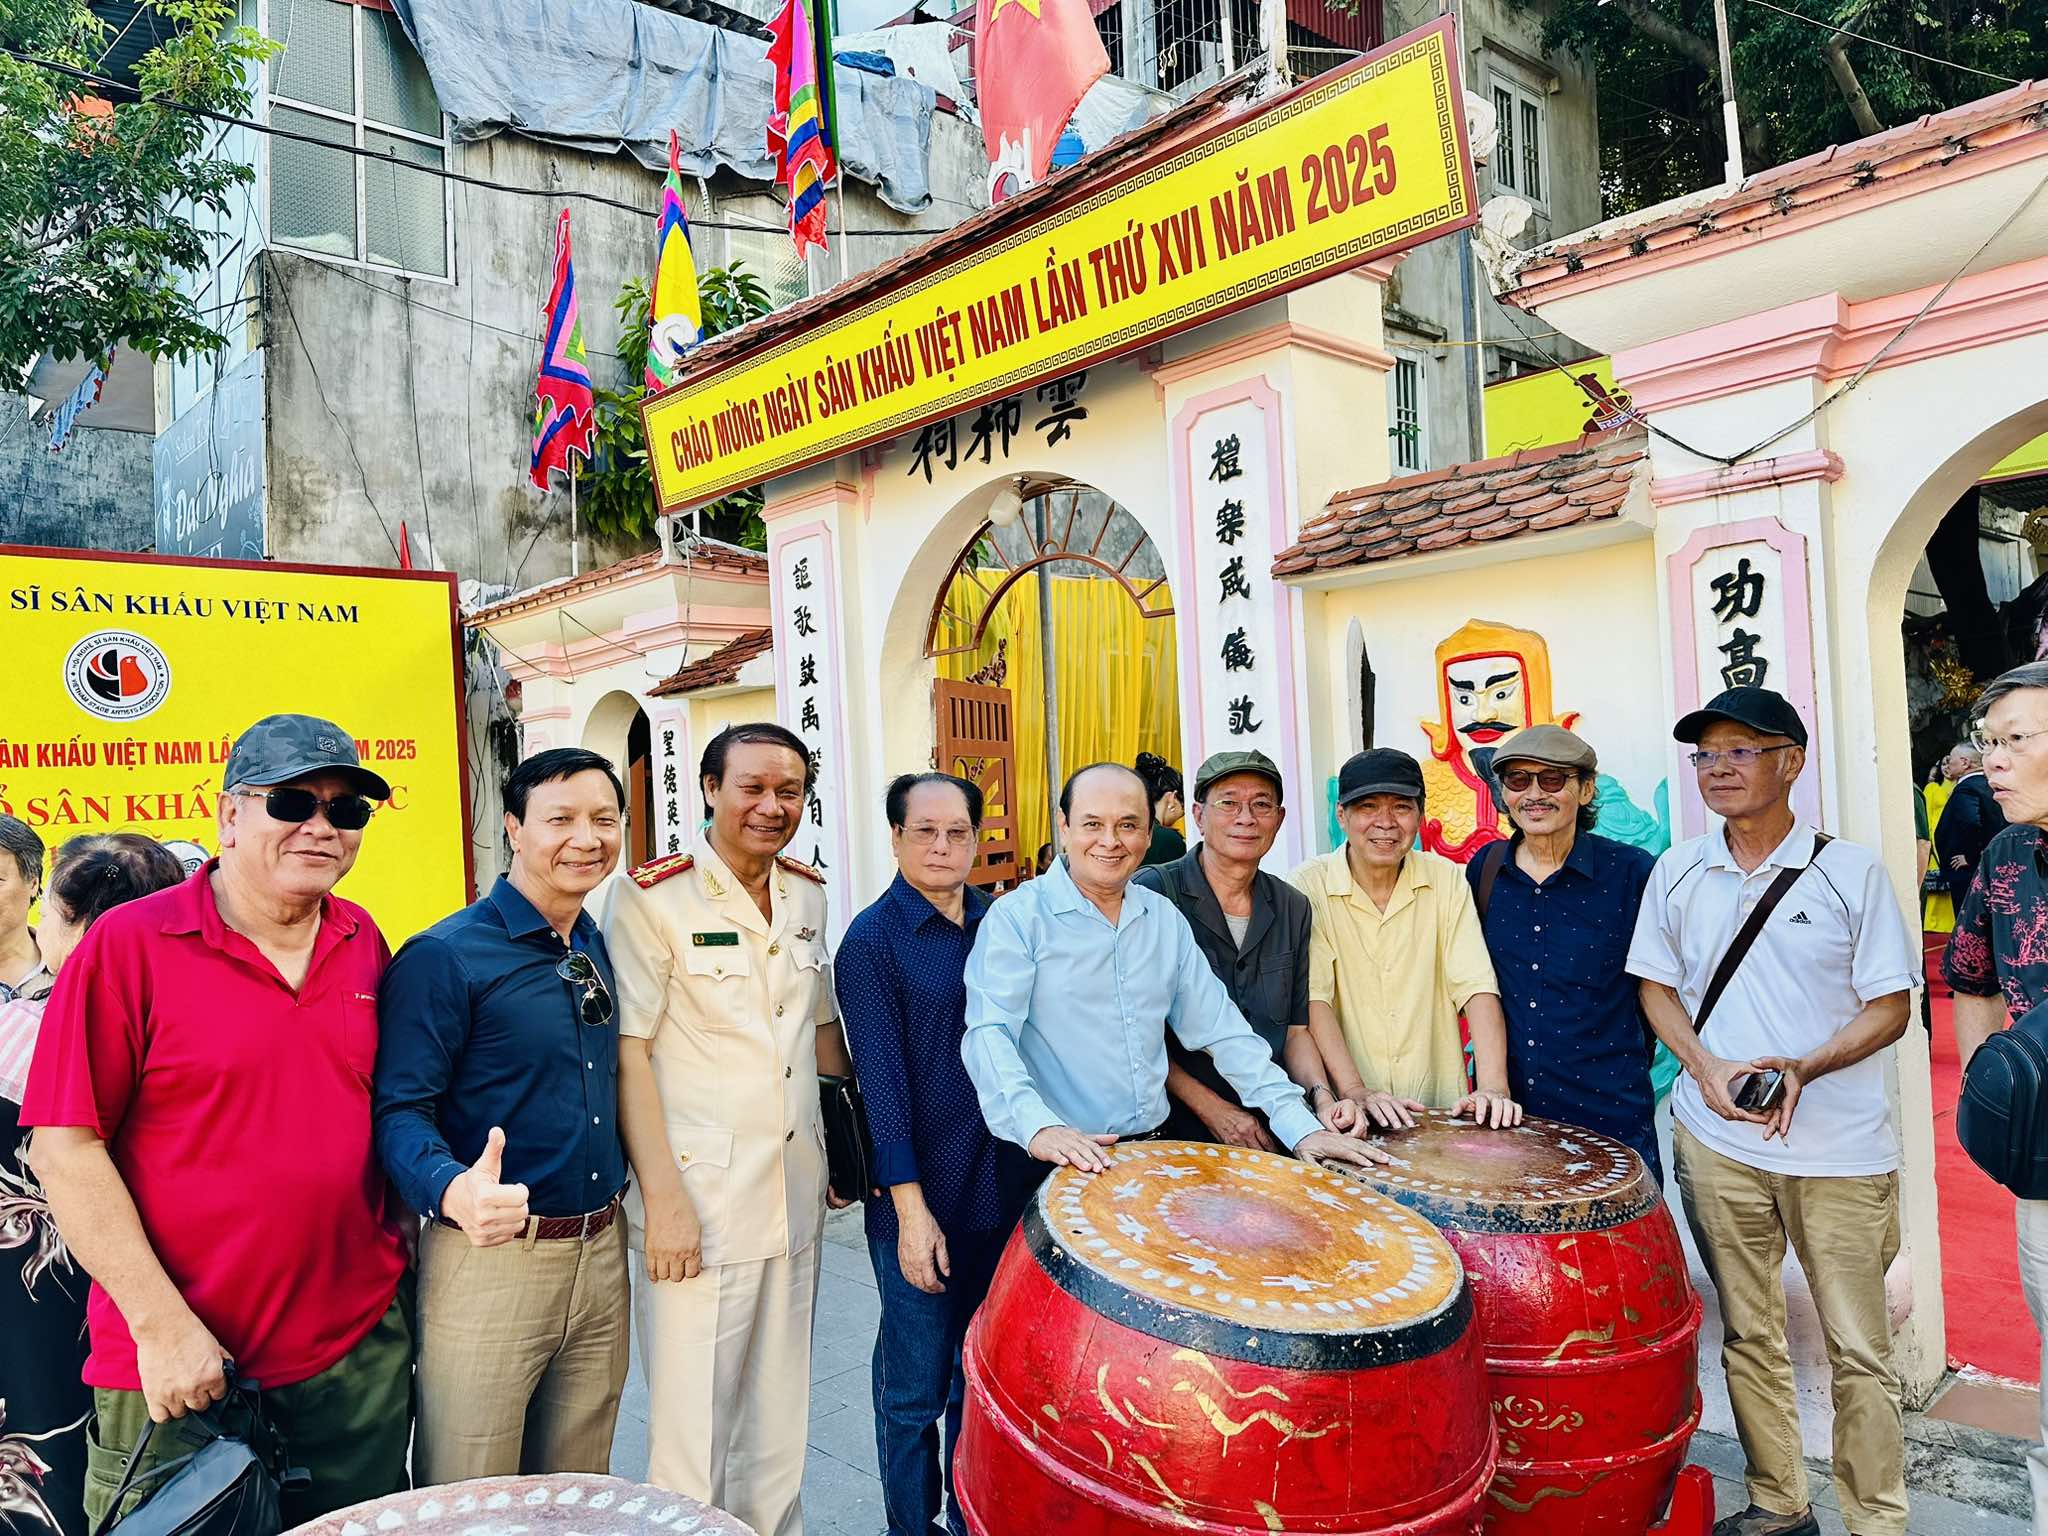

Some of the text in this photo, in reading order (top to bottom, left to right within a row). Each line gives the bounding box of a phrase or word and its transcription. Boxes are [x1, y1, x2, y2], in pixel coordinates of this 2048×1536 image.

[671, 122, 1397, 473] CHÀO MỪNG NGÀY SÂN KHẤU VIỆT NAM LẦN THỨ XVI NĂM 2025
[11, 585, 359, 624] SĨ SÂN KHẤU VIỆT NAM
[37, 734, 96, 767] KHẤU
[103, 737, 147, 771] VIỆT
[155, 741, 201, 765] NAM
[209, 733, 233, 763] LẦ
[375, 739, 416, 760] 2025
[27, 788, 111, 827] SÂN
[125, 778, 222, 822] KHẤ
